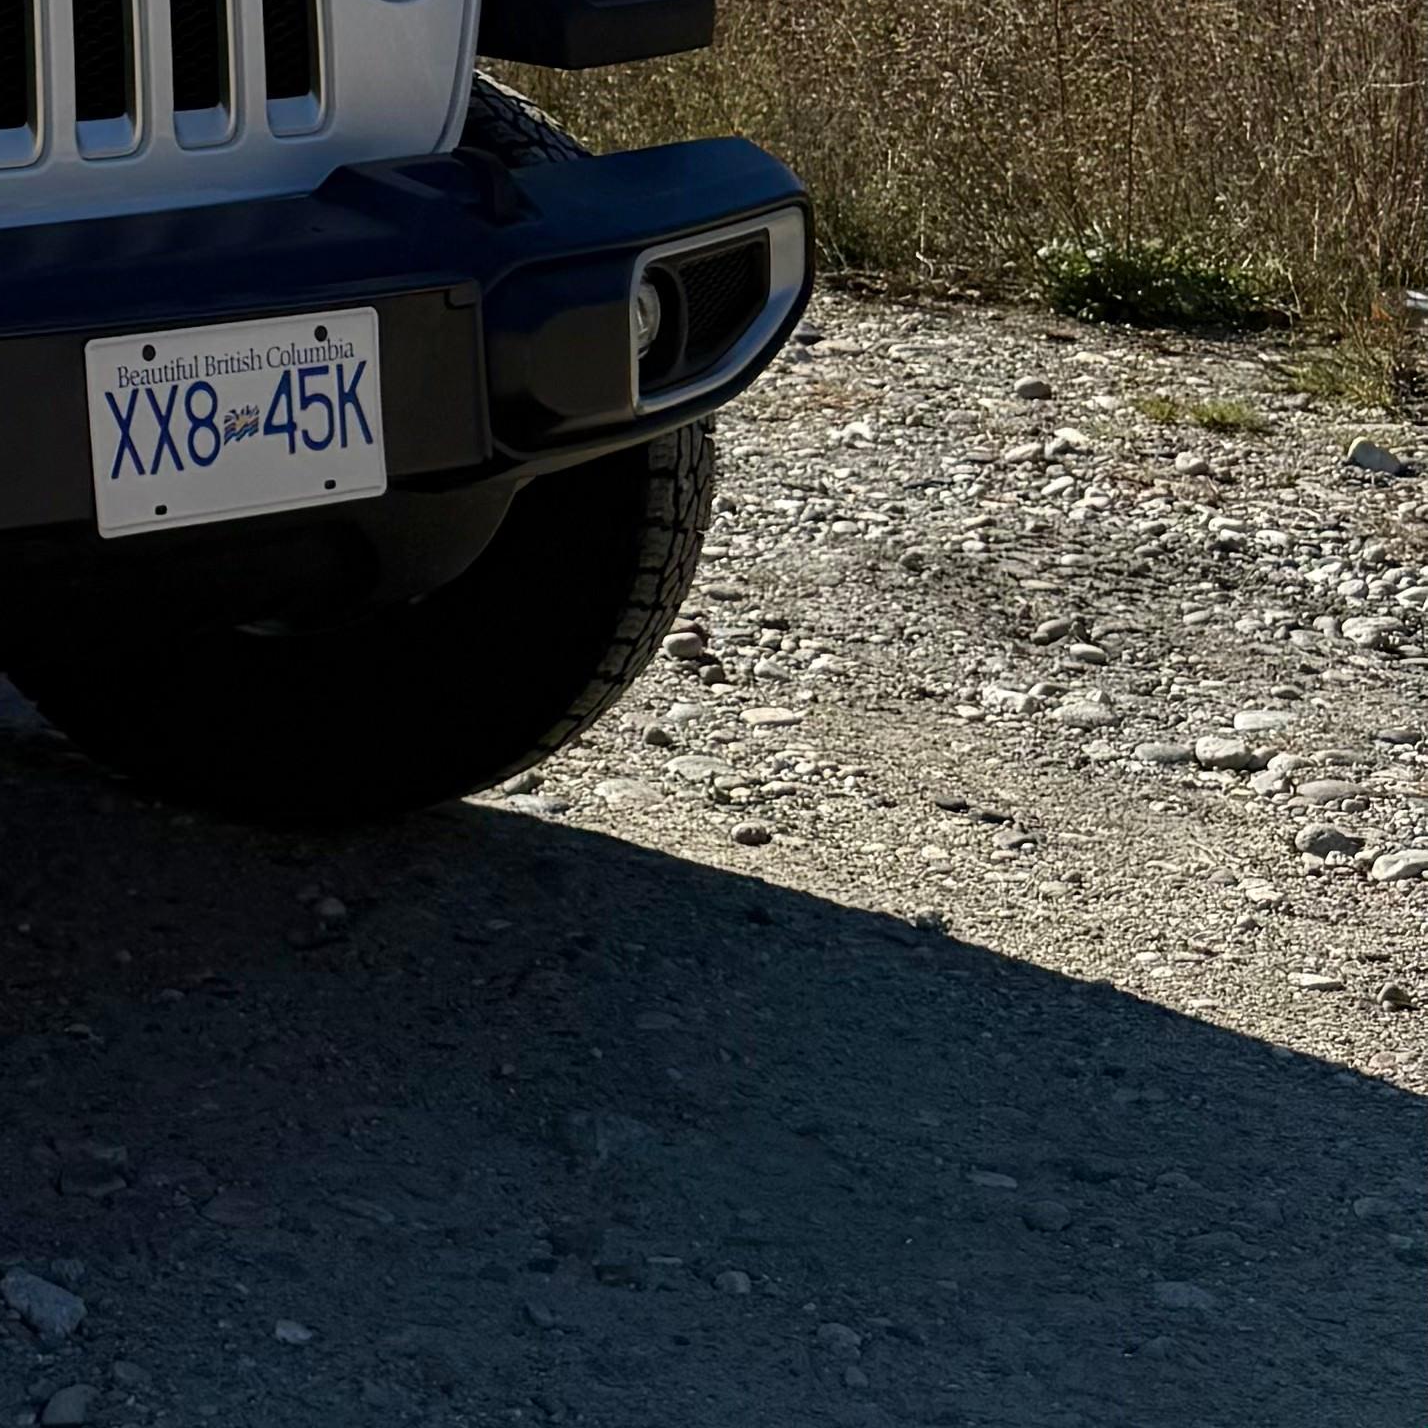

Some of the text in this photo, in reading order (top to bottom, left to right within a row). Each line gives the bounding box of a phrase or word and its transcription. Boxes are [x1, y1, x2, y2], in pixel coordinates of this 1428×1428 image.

[118, 339, 354, 388] Beautiful British Columbia
[105, 360, 374, 479] XX8 45K
